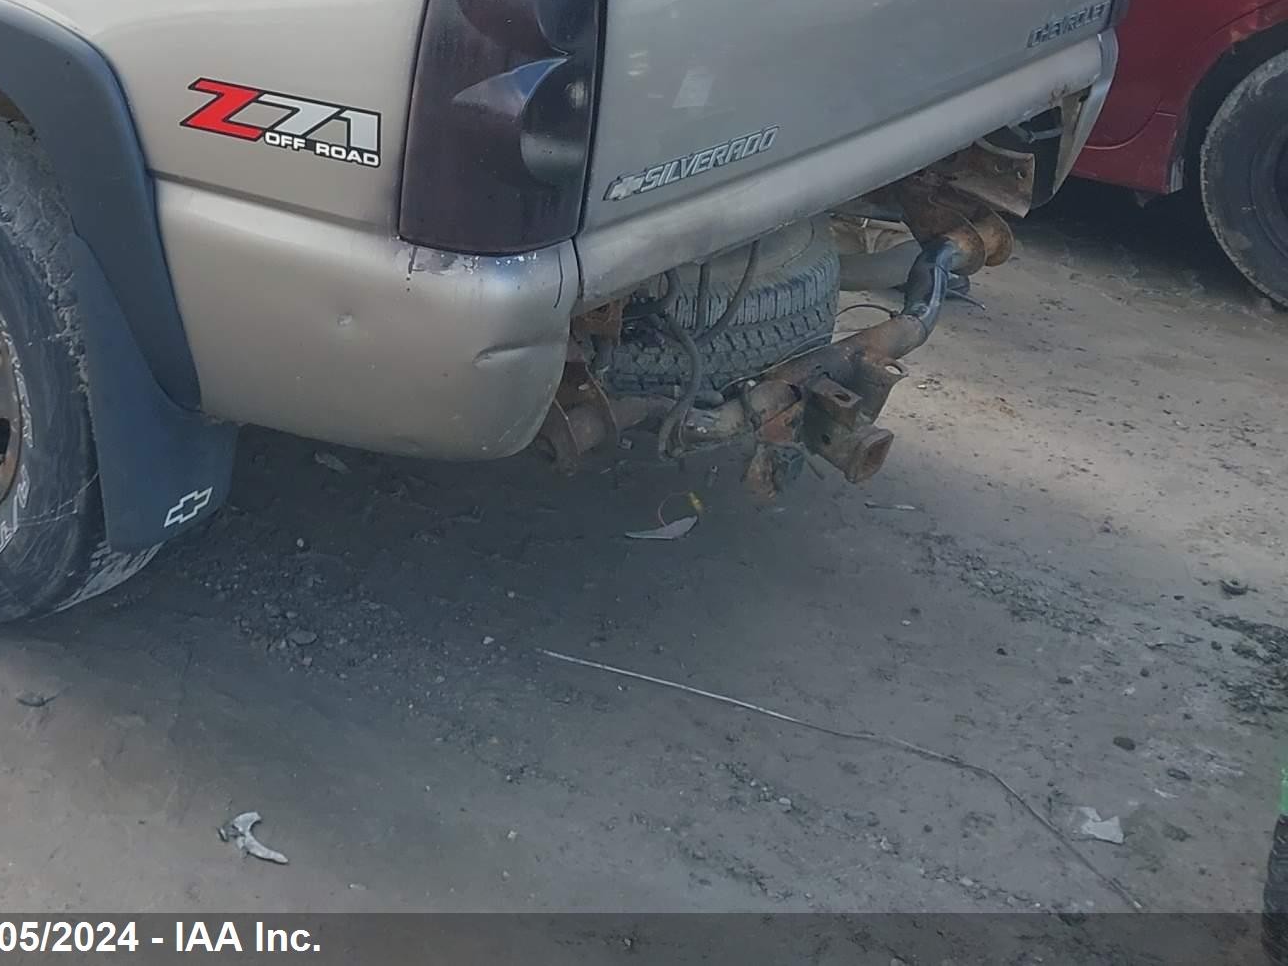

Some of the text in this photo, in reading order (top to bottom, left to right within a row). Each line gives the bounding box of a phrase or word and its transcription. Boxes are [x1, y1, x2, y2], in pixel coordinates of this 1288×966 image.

[1027, 0, 1111, 48] CHEVROLET
[180, 77, 381, 152] Z71
[264, 132, 381, 167] OFF ROAD
[640, 125, 780, 193] SILVERADO
